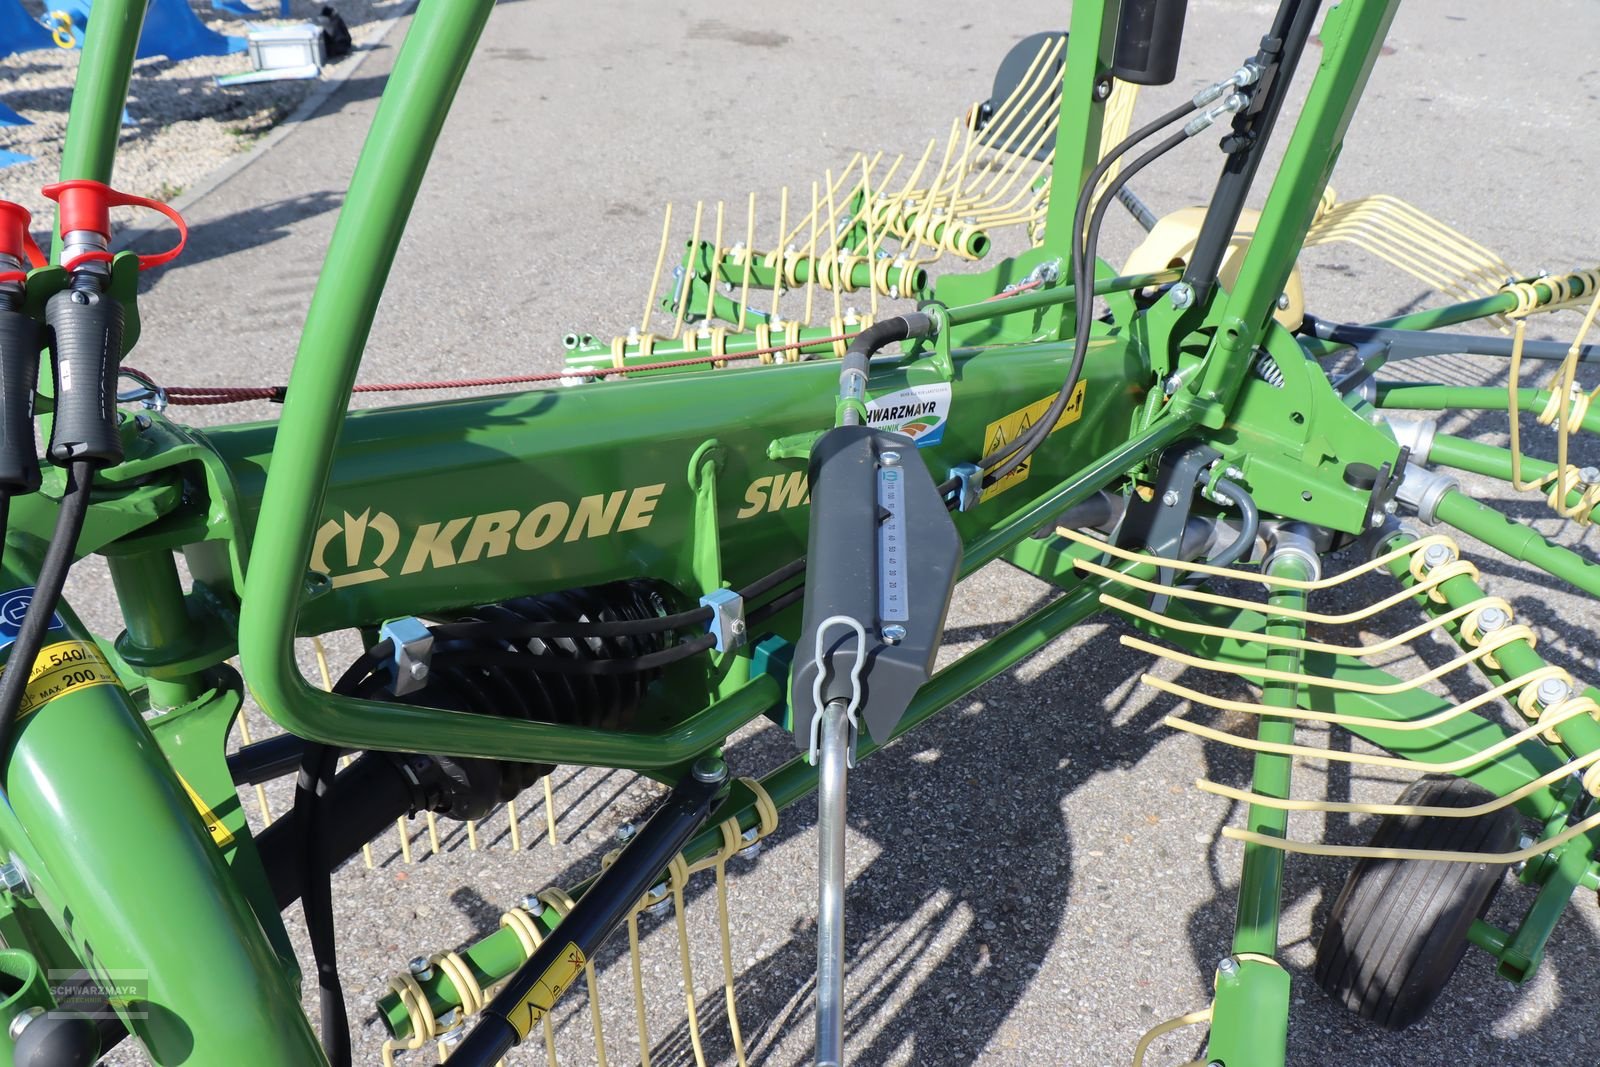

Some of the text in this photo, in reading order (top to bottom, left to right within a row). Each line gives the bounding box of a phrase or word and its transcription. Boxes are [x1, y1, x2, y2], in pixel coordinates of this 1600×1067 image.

[867, 401, 936, 423] HWARZMAYR
[737, 470, 810, 519] SW
[400, 483, 666, 575] KRONE
[62, 669, 96, 687] 200
